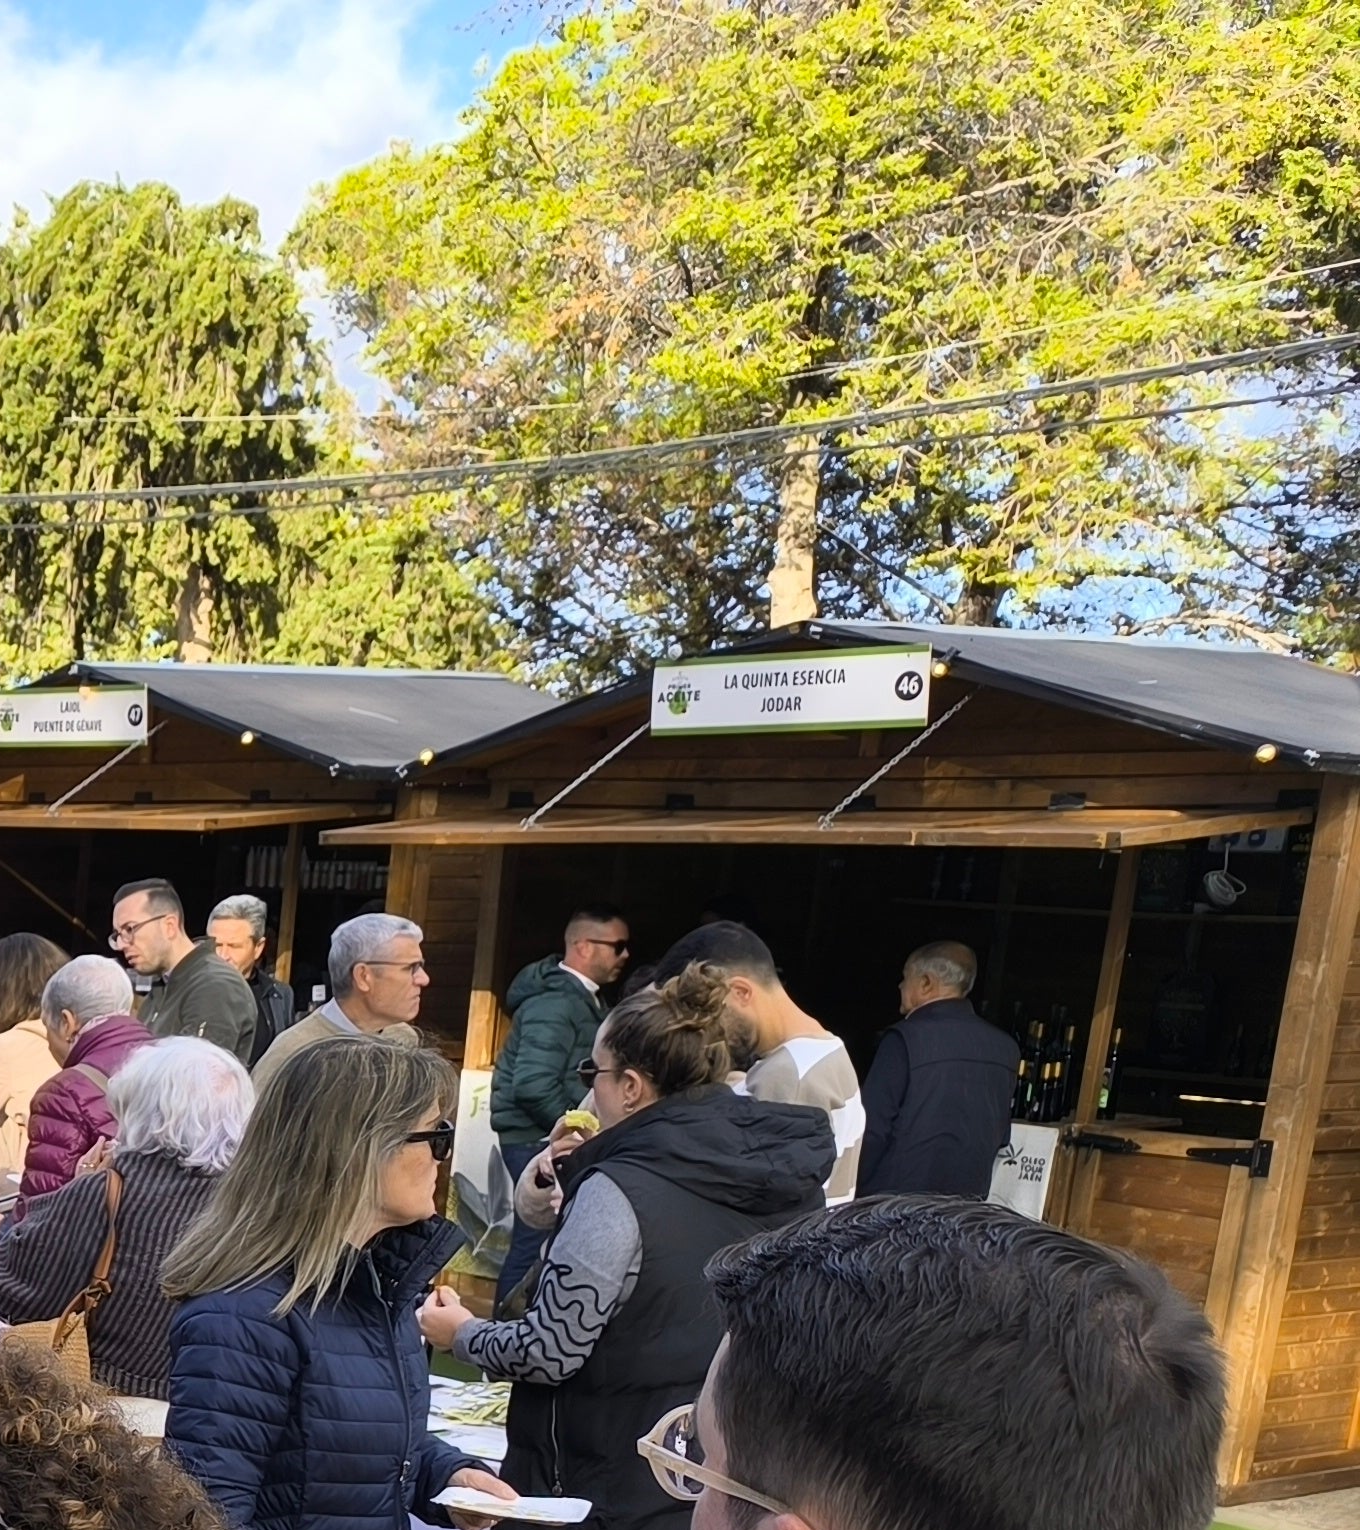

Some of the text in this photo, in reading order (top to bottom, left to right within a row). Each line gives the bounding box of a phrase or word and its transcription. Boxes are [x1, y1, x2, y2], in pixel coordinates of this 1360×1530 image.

[724, 668, 920, 696] LA QUINTA ESENCIA 46
[760, 696, 803, 713] JODAR
[129, 707, 142, 723] 47
[33, 720, 65, 732] PUENTE
[66, 720, 75, 732] DE
[1020, 1164, 1044, 1174] TOUR
